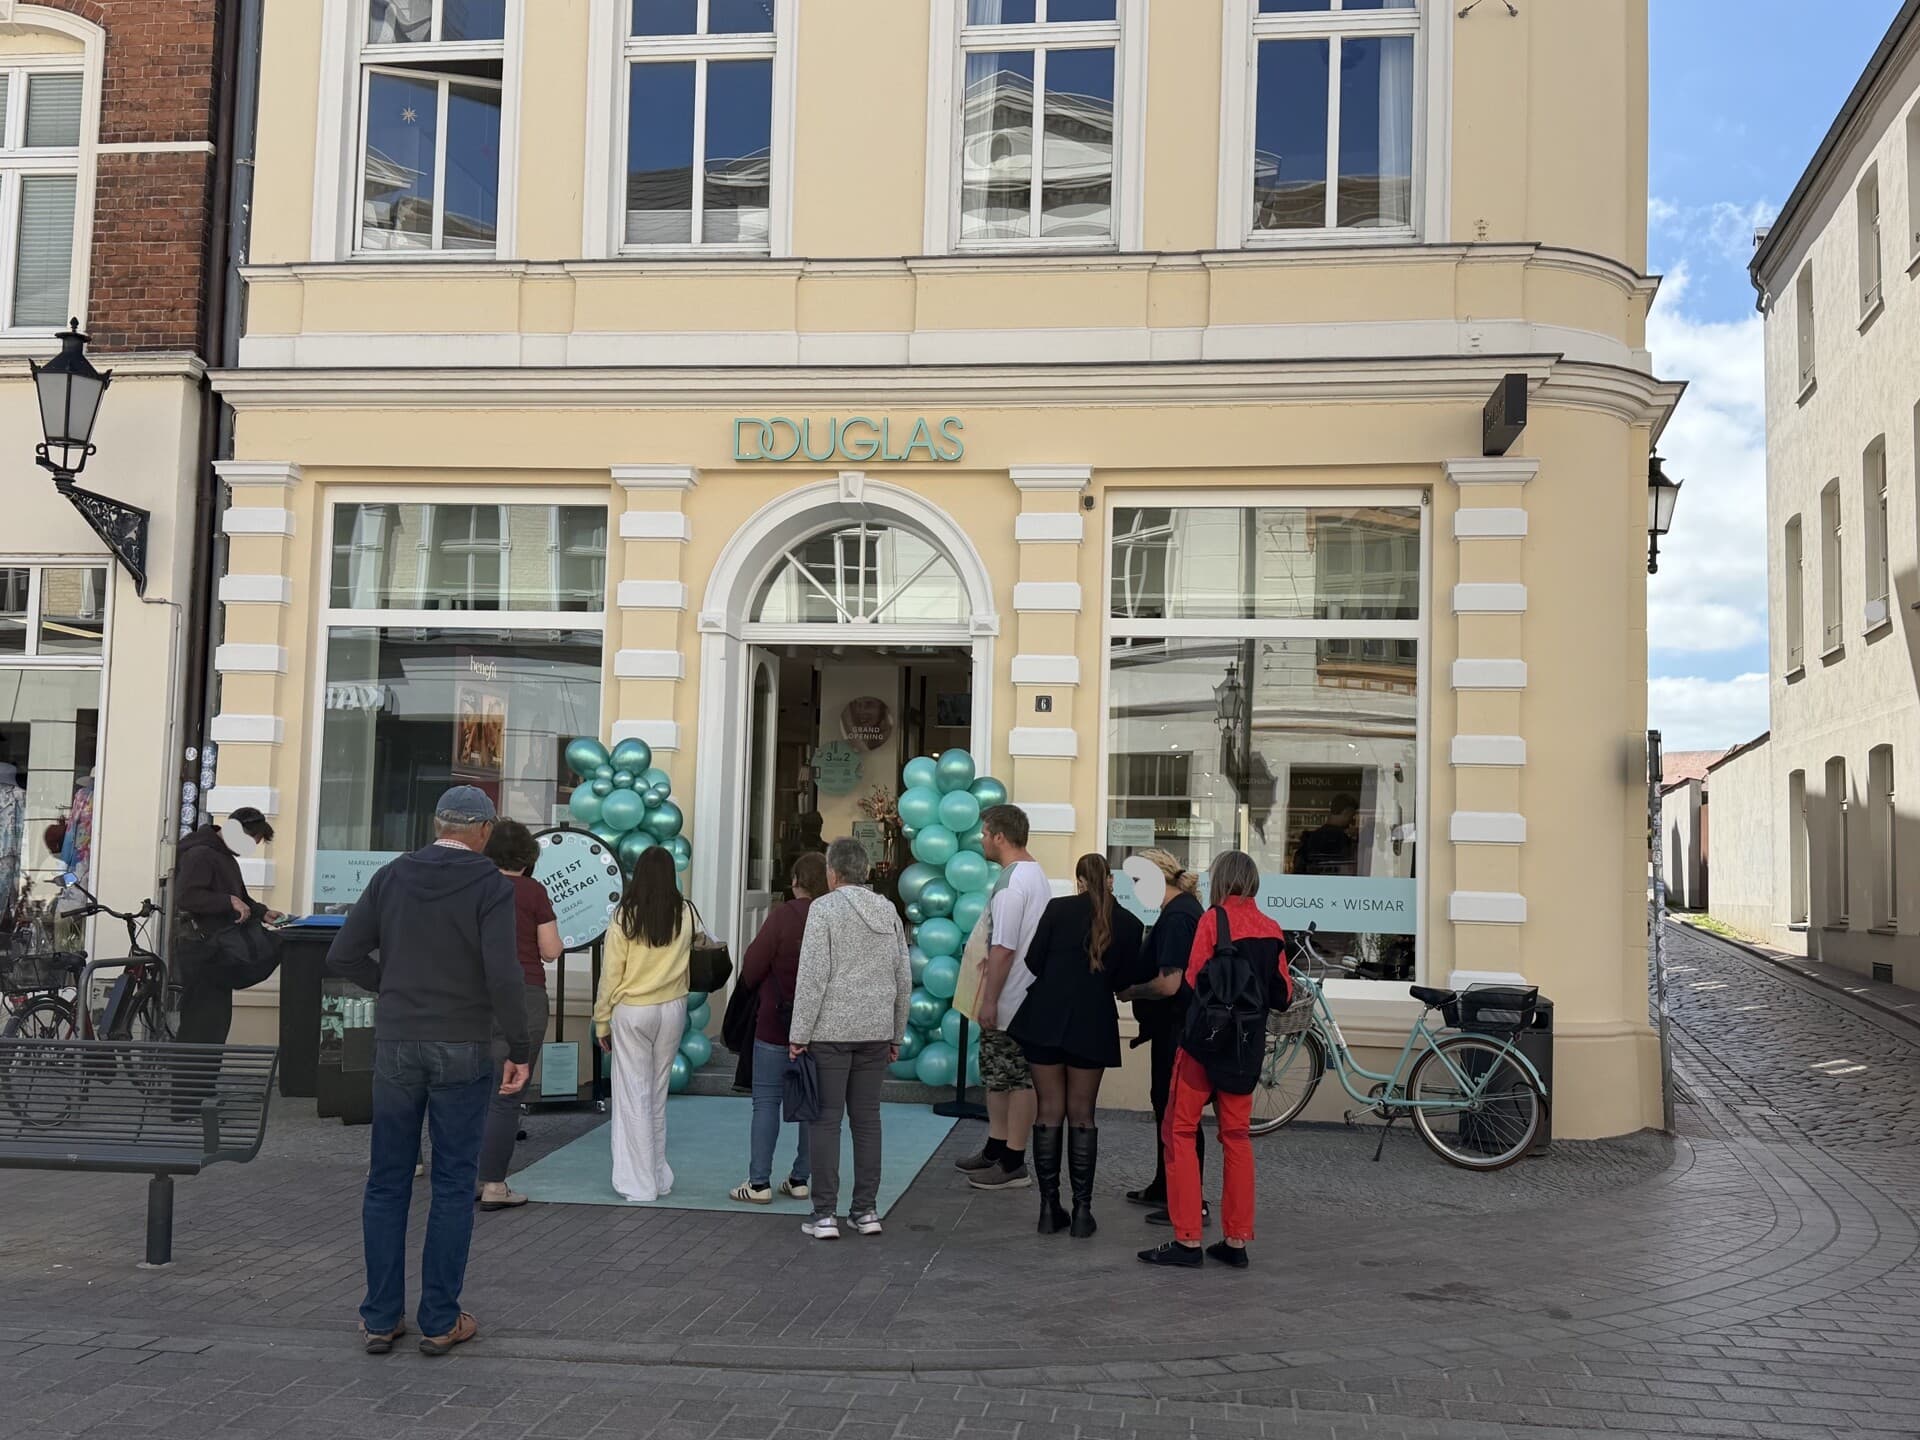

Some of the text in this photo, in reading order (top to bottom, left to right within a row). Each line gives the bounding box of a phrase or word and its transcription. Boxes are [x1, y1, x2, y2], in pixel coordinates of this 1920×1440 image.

[734, 416, 964, 462] DOUGLAS
[470, 654, 497, 681] benefit
[1041, 698, 1047, 710] 6
[543, 860, 582, 885] UTE IST
[550, 875, 599, 905] CKSTAG!
[552, 879, 570, 893] IHR
[1267, 896, 1324, 909] DOUGLAS
[1343, 898, 1404, 912] WISMAR
